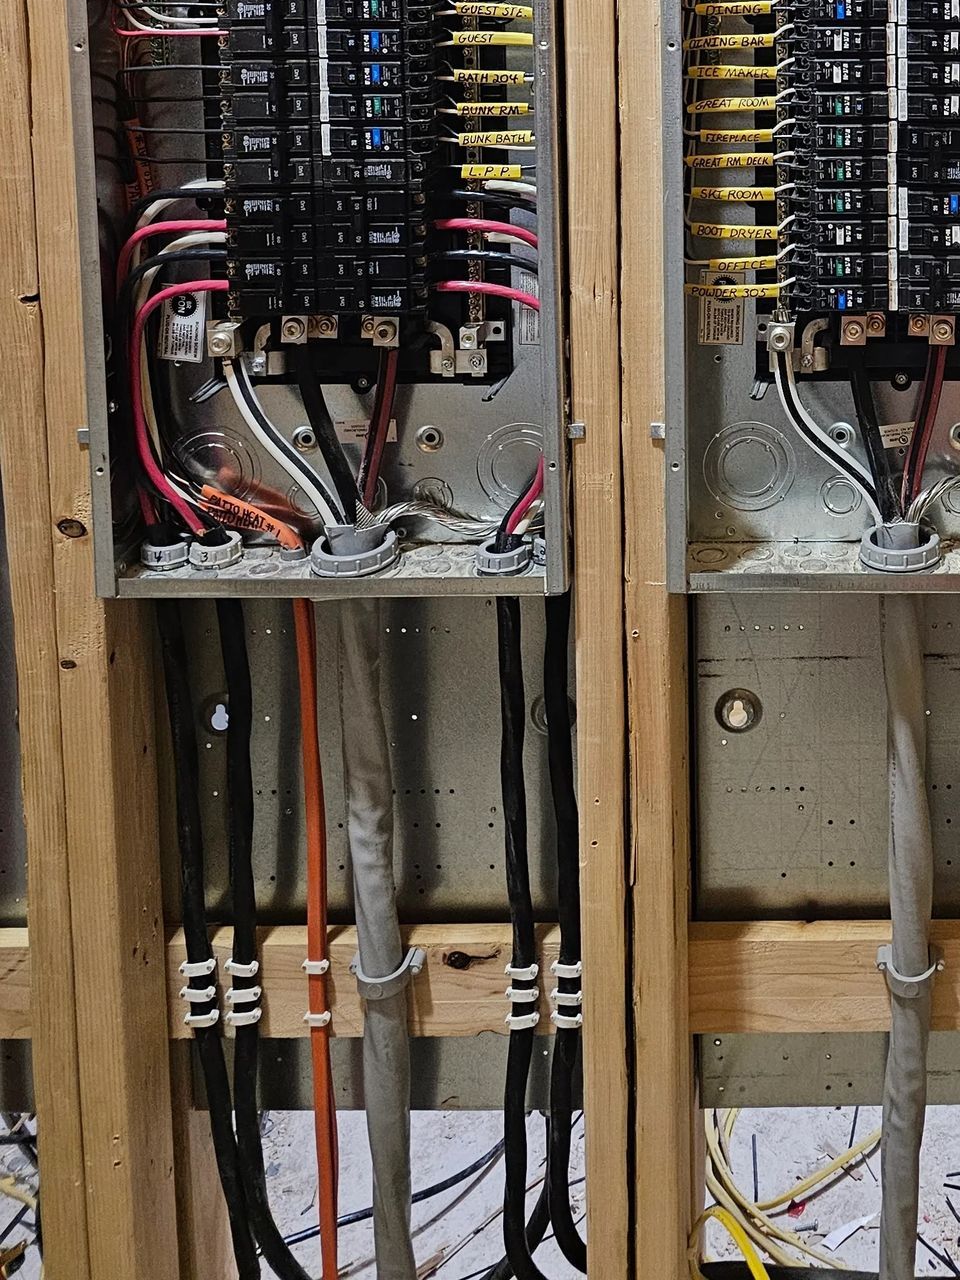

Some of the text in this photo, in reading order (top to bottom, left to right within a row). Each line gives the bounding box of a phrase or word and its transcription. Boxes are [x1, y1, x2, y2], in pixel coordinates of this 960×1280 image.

[461, 4, 497, 15] GUEST
[706, 4, 763, 15] DINING
[458, 34, 493, 44] GUEST
[689, 36, 765, 48] DINING BAR
[458, 72, 519, 84] BATH 204
[697, 67, 769, 78] ICE MAKER
[695, 98, 769, 110] GREAT ROOM
[461, 105, 495, 115] BUNK
[462, 132, 526, 145] BUNK BATH
[706, 133, 760, 143] FIREPLACE
[693, 157, 723, 167] GREAT
[747, 156, 769, 166] DECK
[700, 189, 764, 199] SKI ROOM
[697, 226, 772, 238] BOOT DRYER
[718, 260, 766, 271] OFFICE
[692, 288, 769, 297] POWDER 305
[178, 296, 186, 314] PON
[209, 494, 240, 515] PATIO
[242, 510, 265, 530] HEAT
[154, 551, 162, 561] 4
[201, 552, 208, 561] 3
